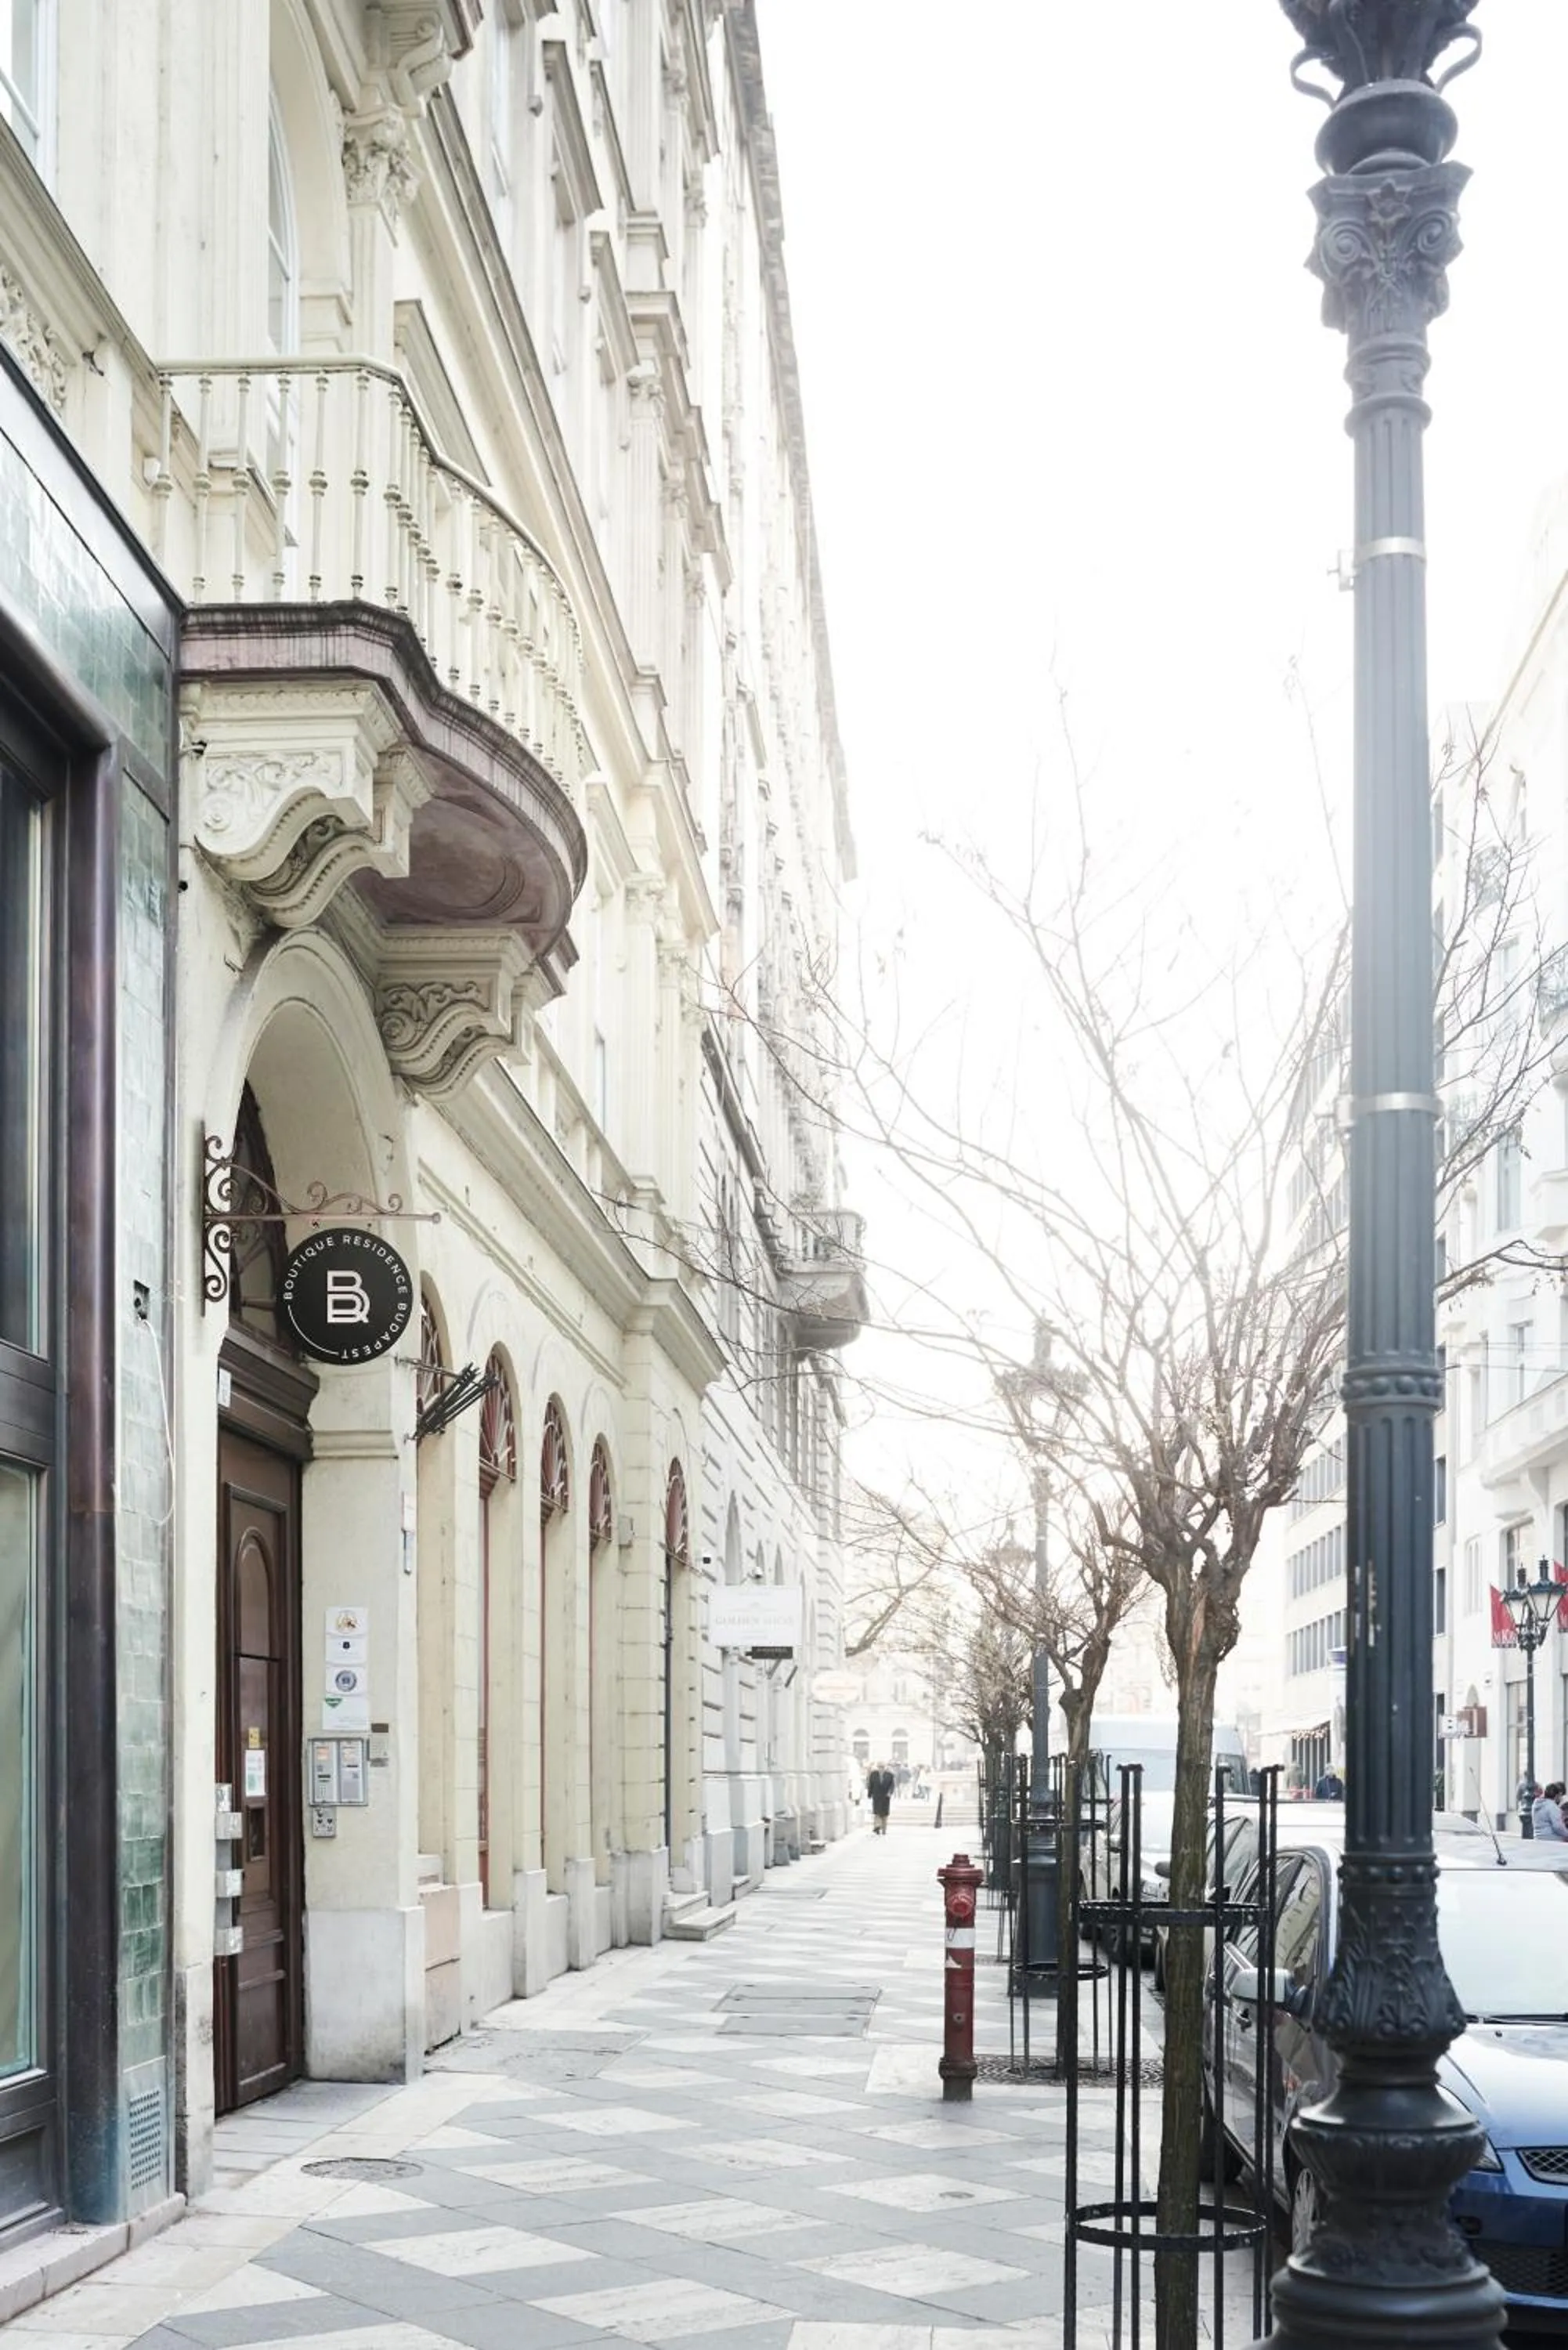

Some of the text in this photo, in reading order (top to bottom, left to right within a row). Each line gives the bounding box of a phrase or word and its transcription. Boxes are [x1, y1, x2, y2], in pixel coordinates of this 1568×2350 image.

[284, 1235, 408, 1359] BOUTIQUE RESIDENCE BUDAPEST
